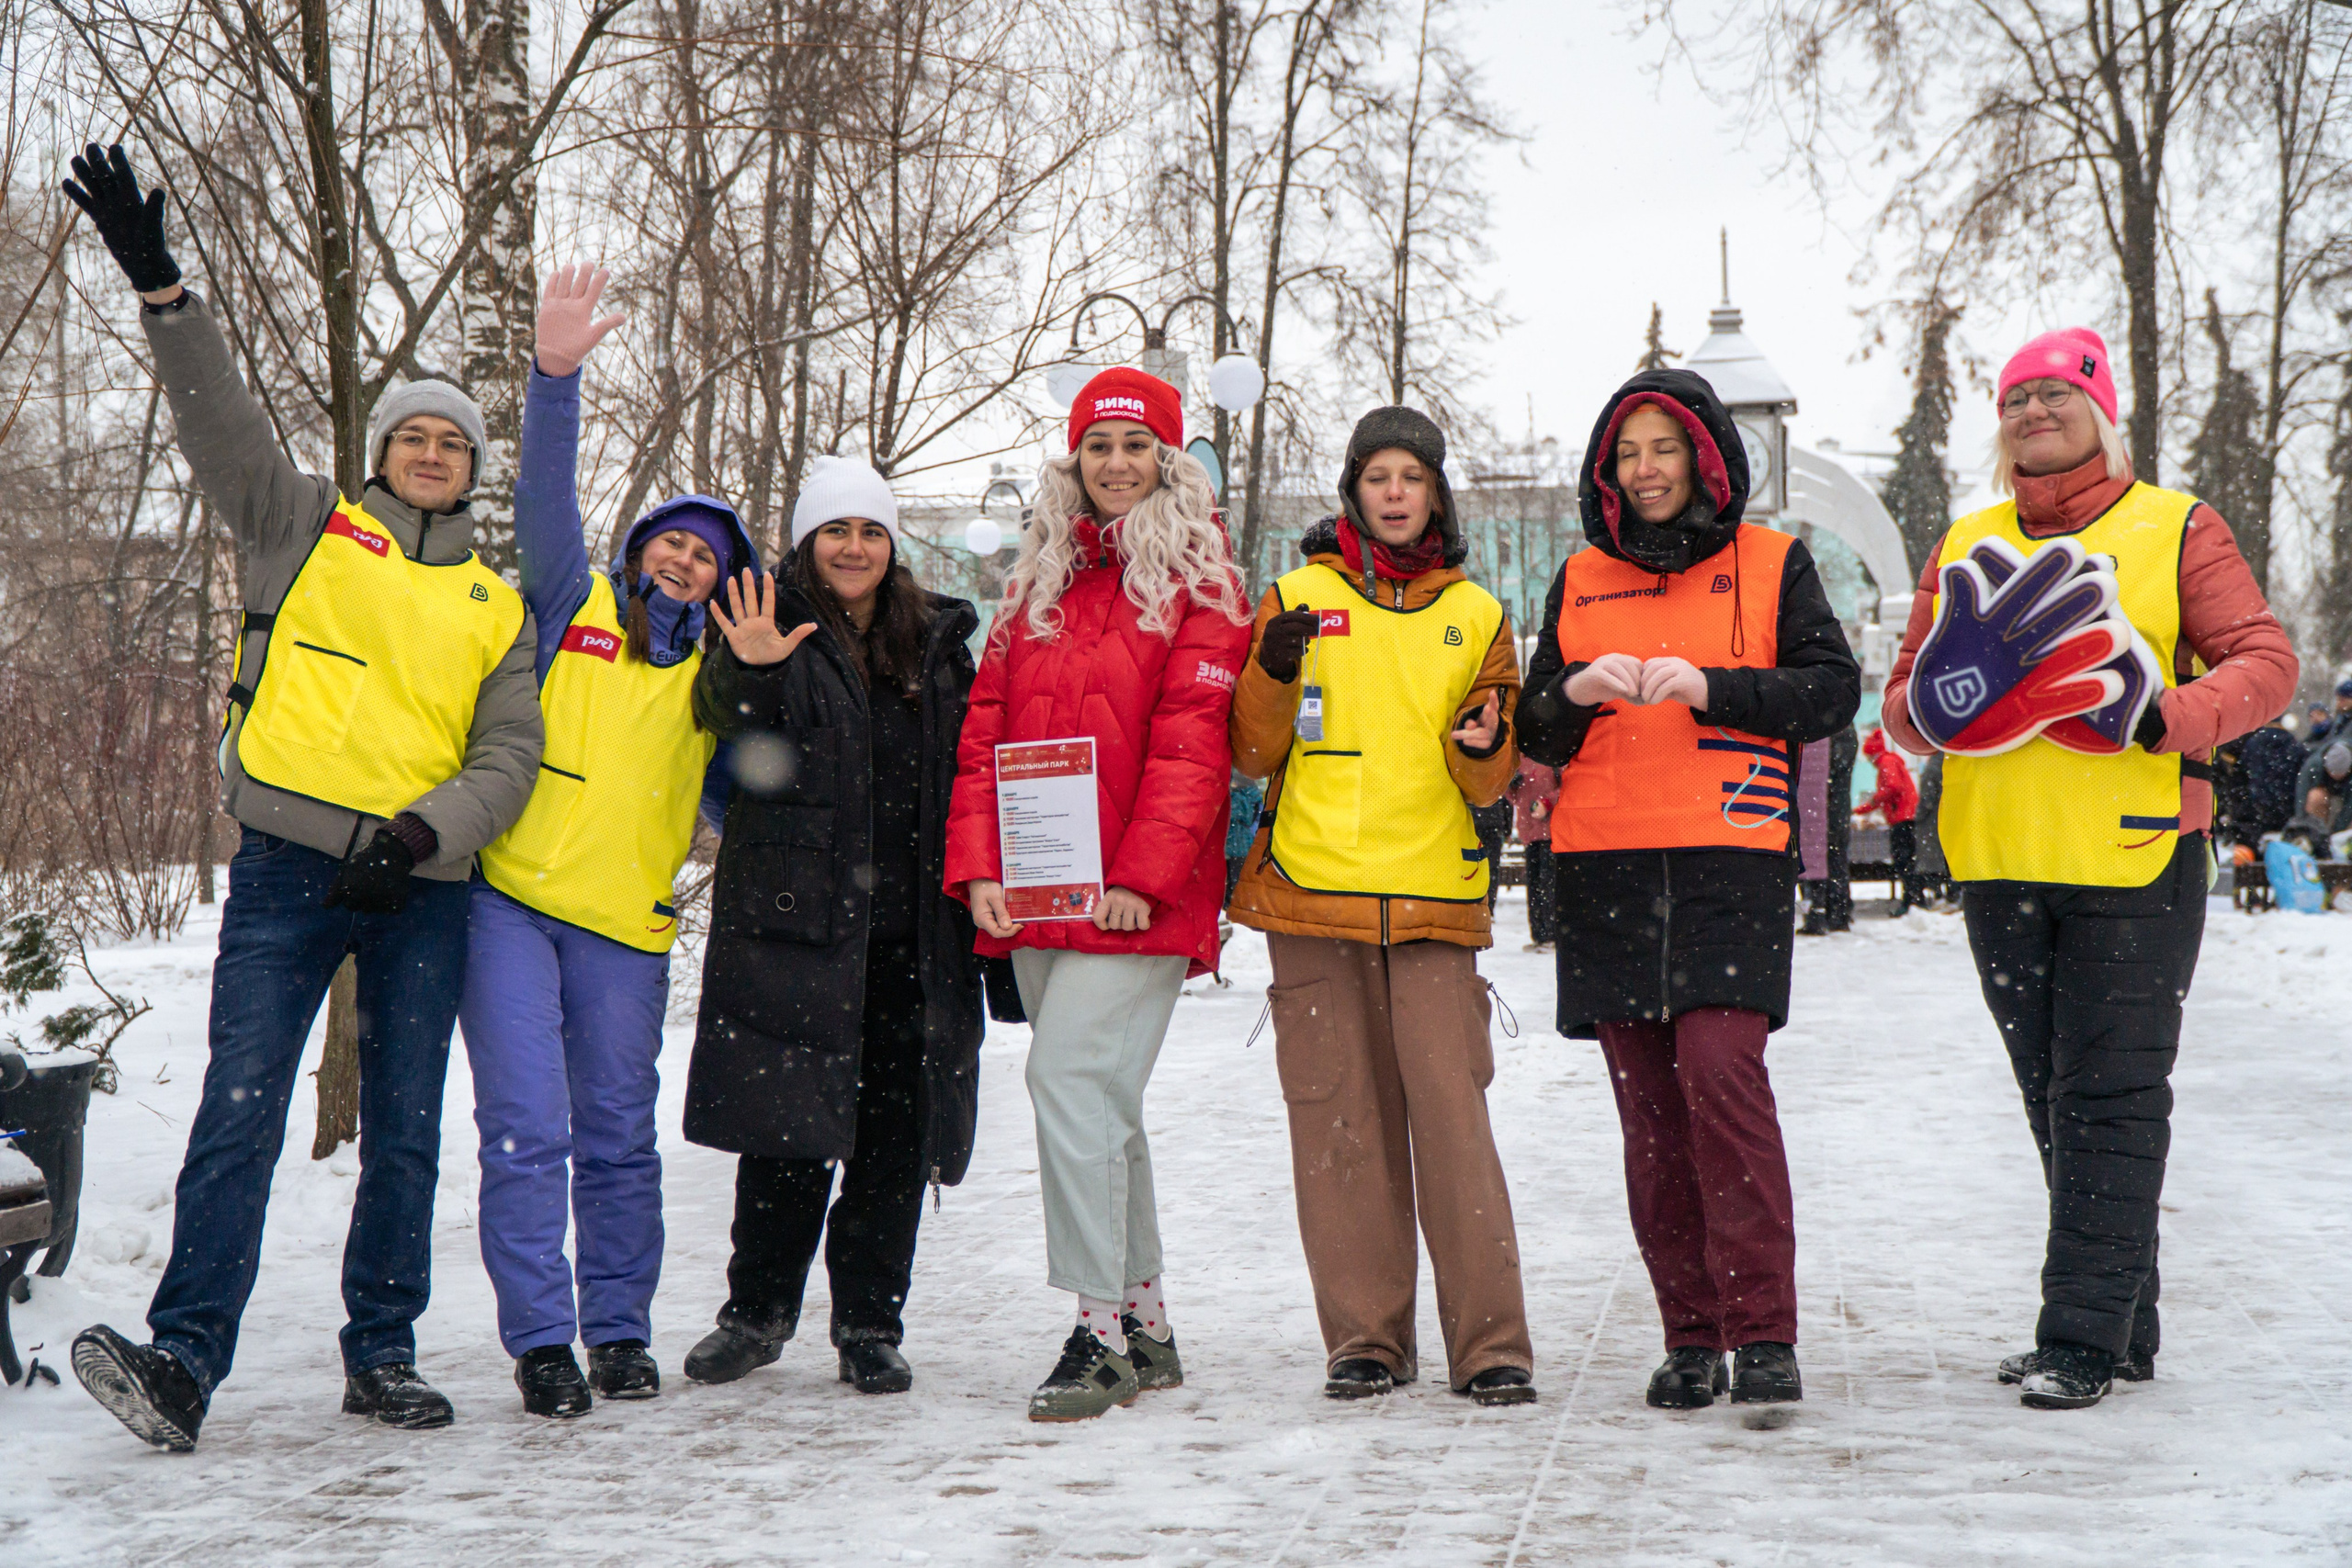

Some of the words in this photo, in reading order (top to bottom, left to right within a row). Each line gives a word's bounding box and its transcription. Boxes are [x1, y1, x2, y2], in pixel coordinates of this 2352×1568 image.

[1094, 397, 1145, 414] ЗИМА
[1196, 660, 1237, 689] ЗИМ
[1000, 761, 1049, 773] ЦЕНТРАЛЬНЫЙ
